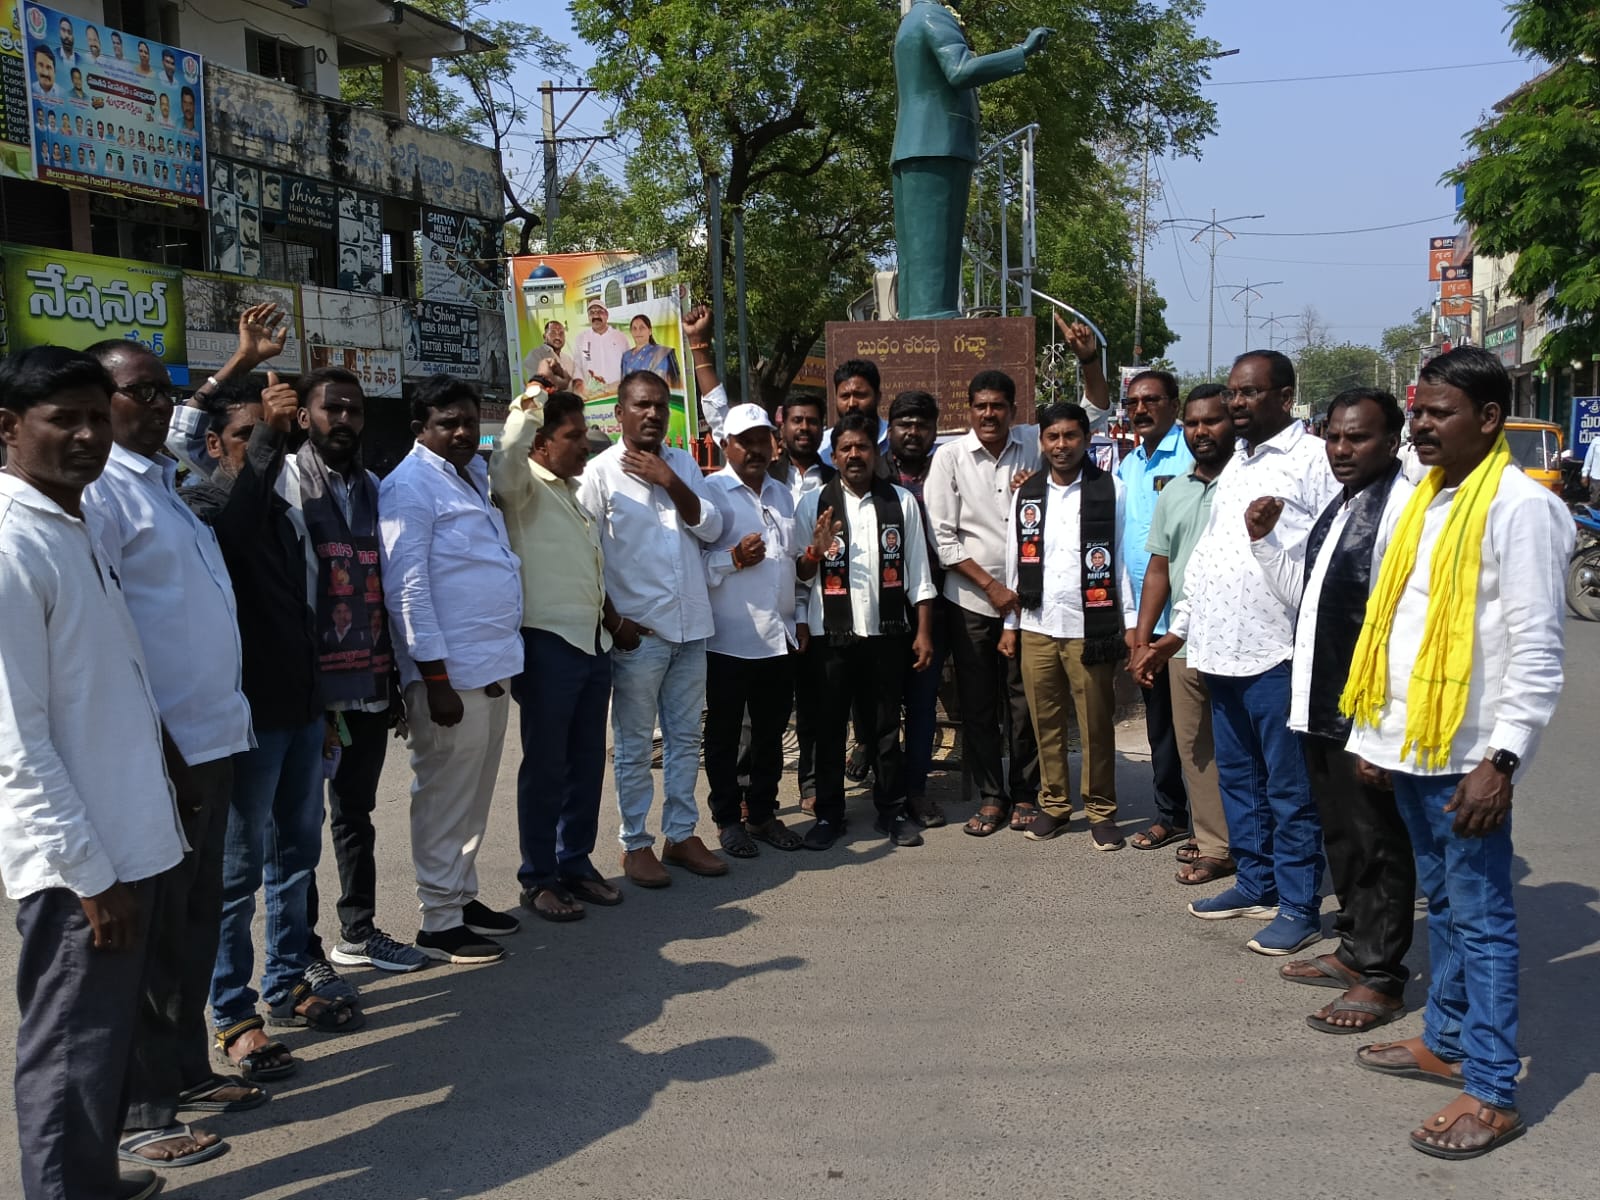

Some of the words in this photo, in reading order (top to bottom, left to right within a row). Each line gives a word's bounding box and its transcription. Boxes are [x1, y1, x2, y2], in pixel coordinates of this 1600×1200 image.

[427, 212, 456, 227] SHIVA
[27, 263, 168, 328] నేషనల్
[432, 305, 456, 322] Shiva
